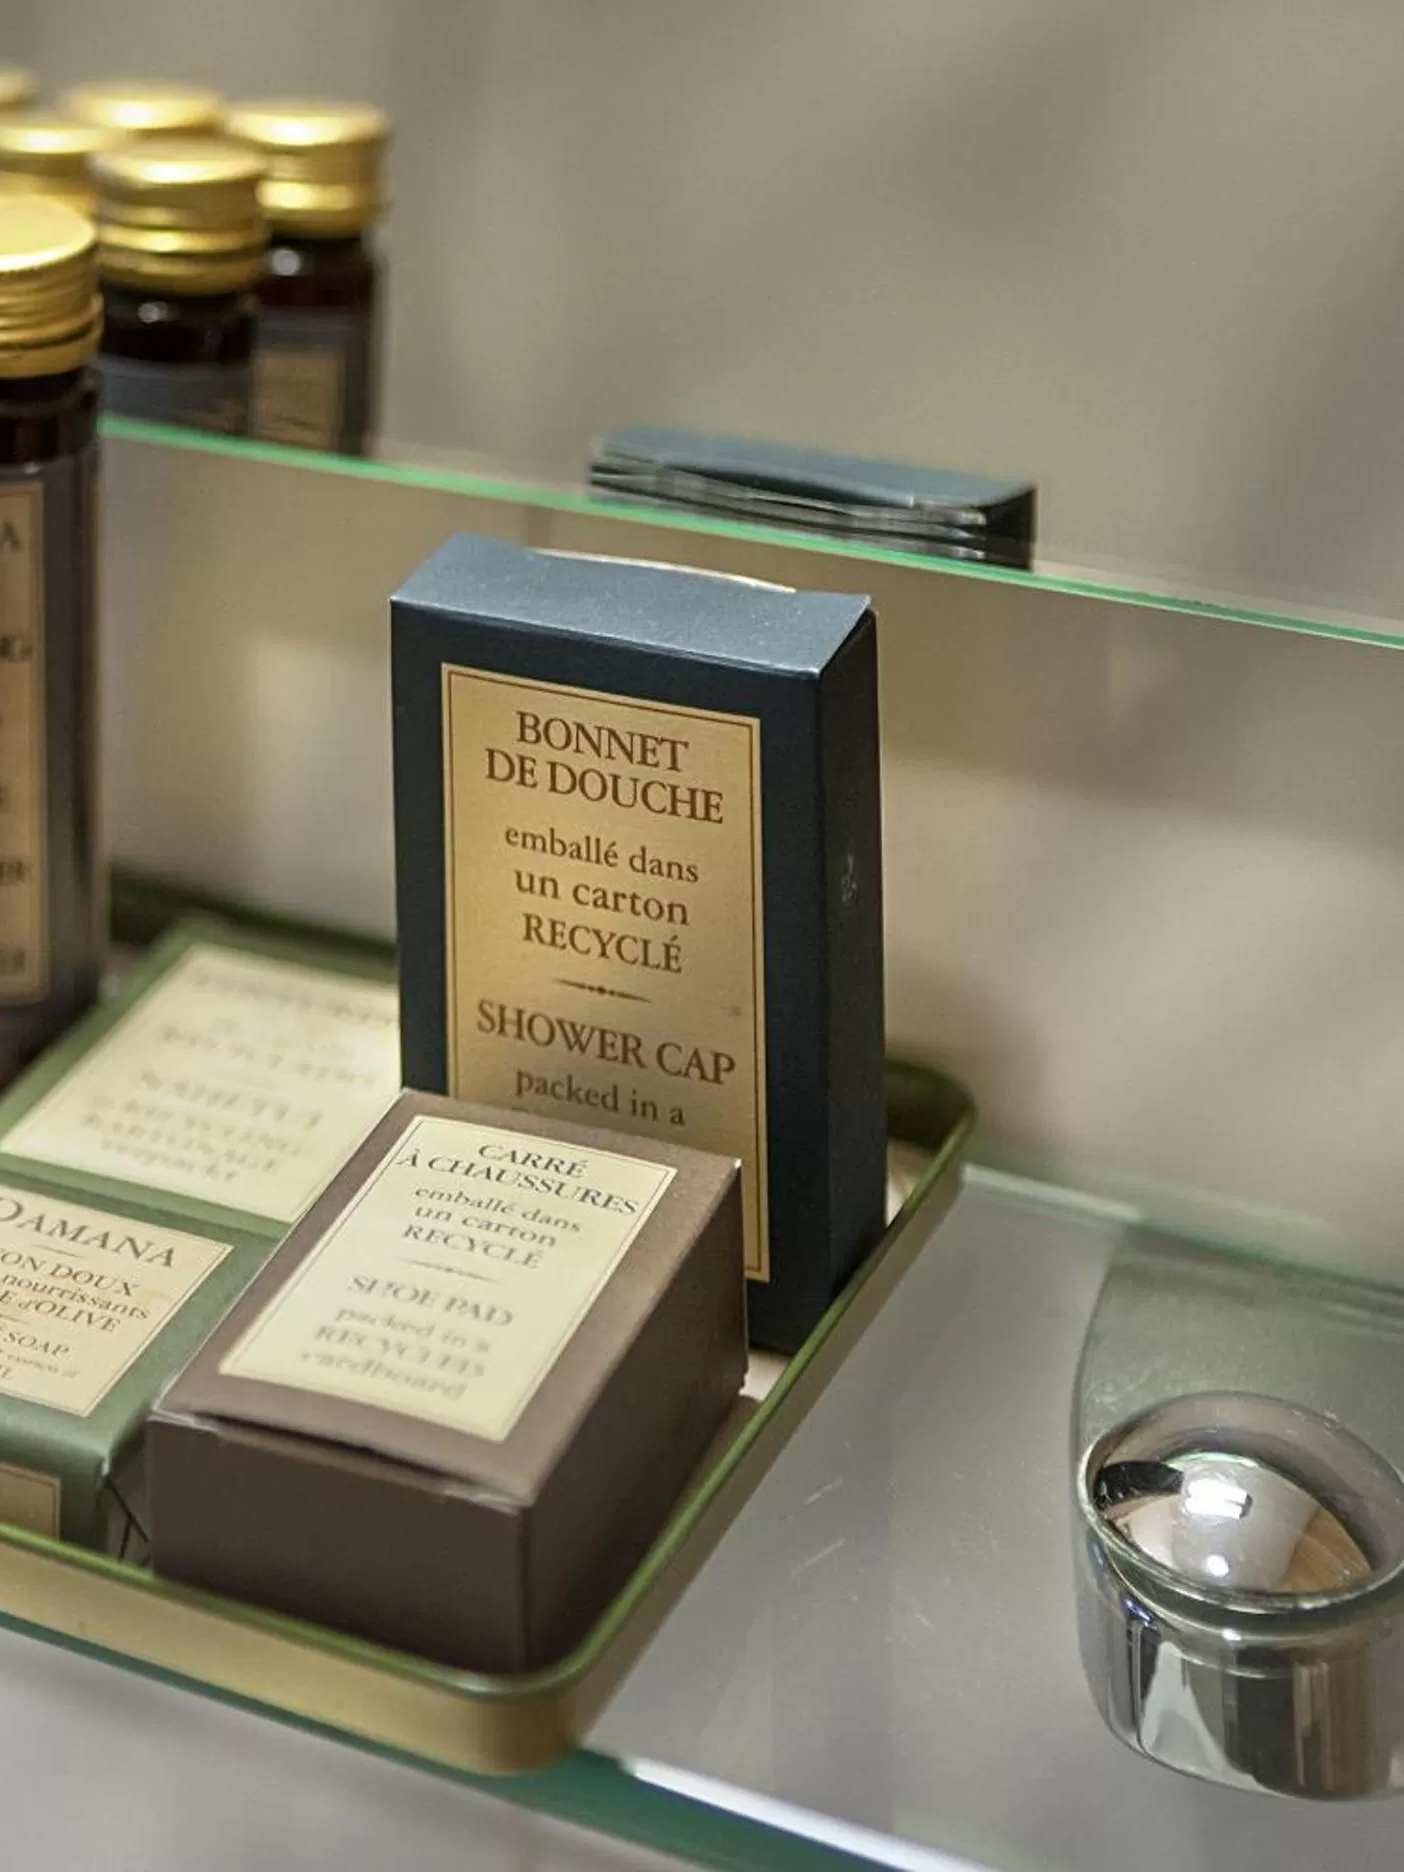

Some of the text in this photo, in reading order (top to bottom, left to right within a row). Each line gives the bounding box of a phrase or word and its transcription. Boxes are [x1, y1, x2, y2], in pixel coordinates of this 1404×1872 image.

[516, 710, 689, 772] BONNET
[485, 748, 724, 824] DE DOUCHE
[505, 825, 699, 884] emballé dans
[514, 870, 690, 926] un carton
[522, 912, 683, 974] RECYCLÉ
[476, 998, 736, 1086] SHOWER CAP
[515, 1069, 686, 1127] packed in a
[396, 1148, 639, 1215] À CHAUSSURES
[479, 1144, 588, 1178] CARRÉ
[414, 1206, 557, 1248] un carton
[415, 1186, 582, 1233] emballé dans
[402, 1224, 544, 1269] RECYCLÉ
[1, 1274, 150, 1319] nourrissants
[49, 1263, 141, 1297] DOUX
[348, 1276, 514, 1327] SHOE PAD
[18, 1297, 121, 1333] d'OLIVE
[4, 1331, 72, 1357] SOAP
